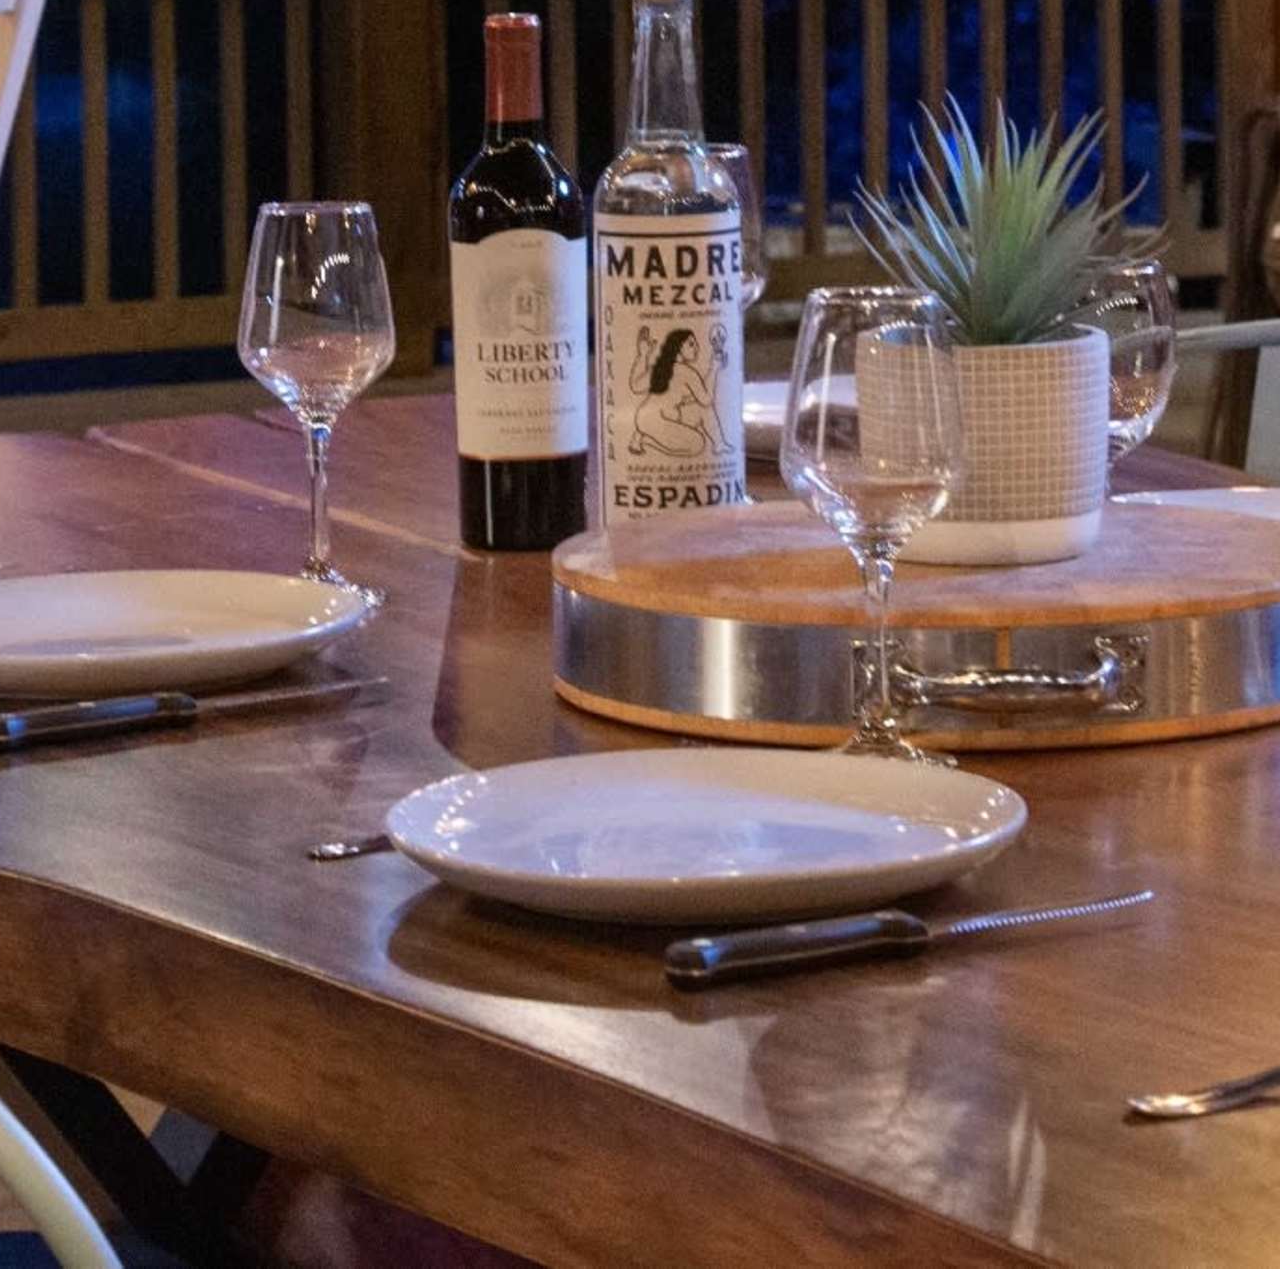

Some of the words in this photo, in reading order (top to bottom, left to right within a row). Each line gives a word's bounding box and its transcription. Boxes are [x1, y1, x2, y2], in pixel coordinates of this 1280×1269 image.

[606, 240, 740, 279] MADRE
[623, 281, 733, 306] MEZCAL
[477, 339, 576, 363] LIBERTY
[484, 364, 568, 384] SCHOOL
[604, 304, 617, 461] OAXACA
